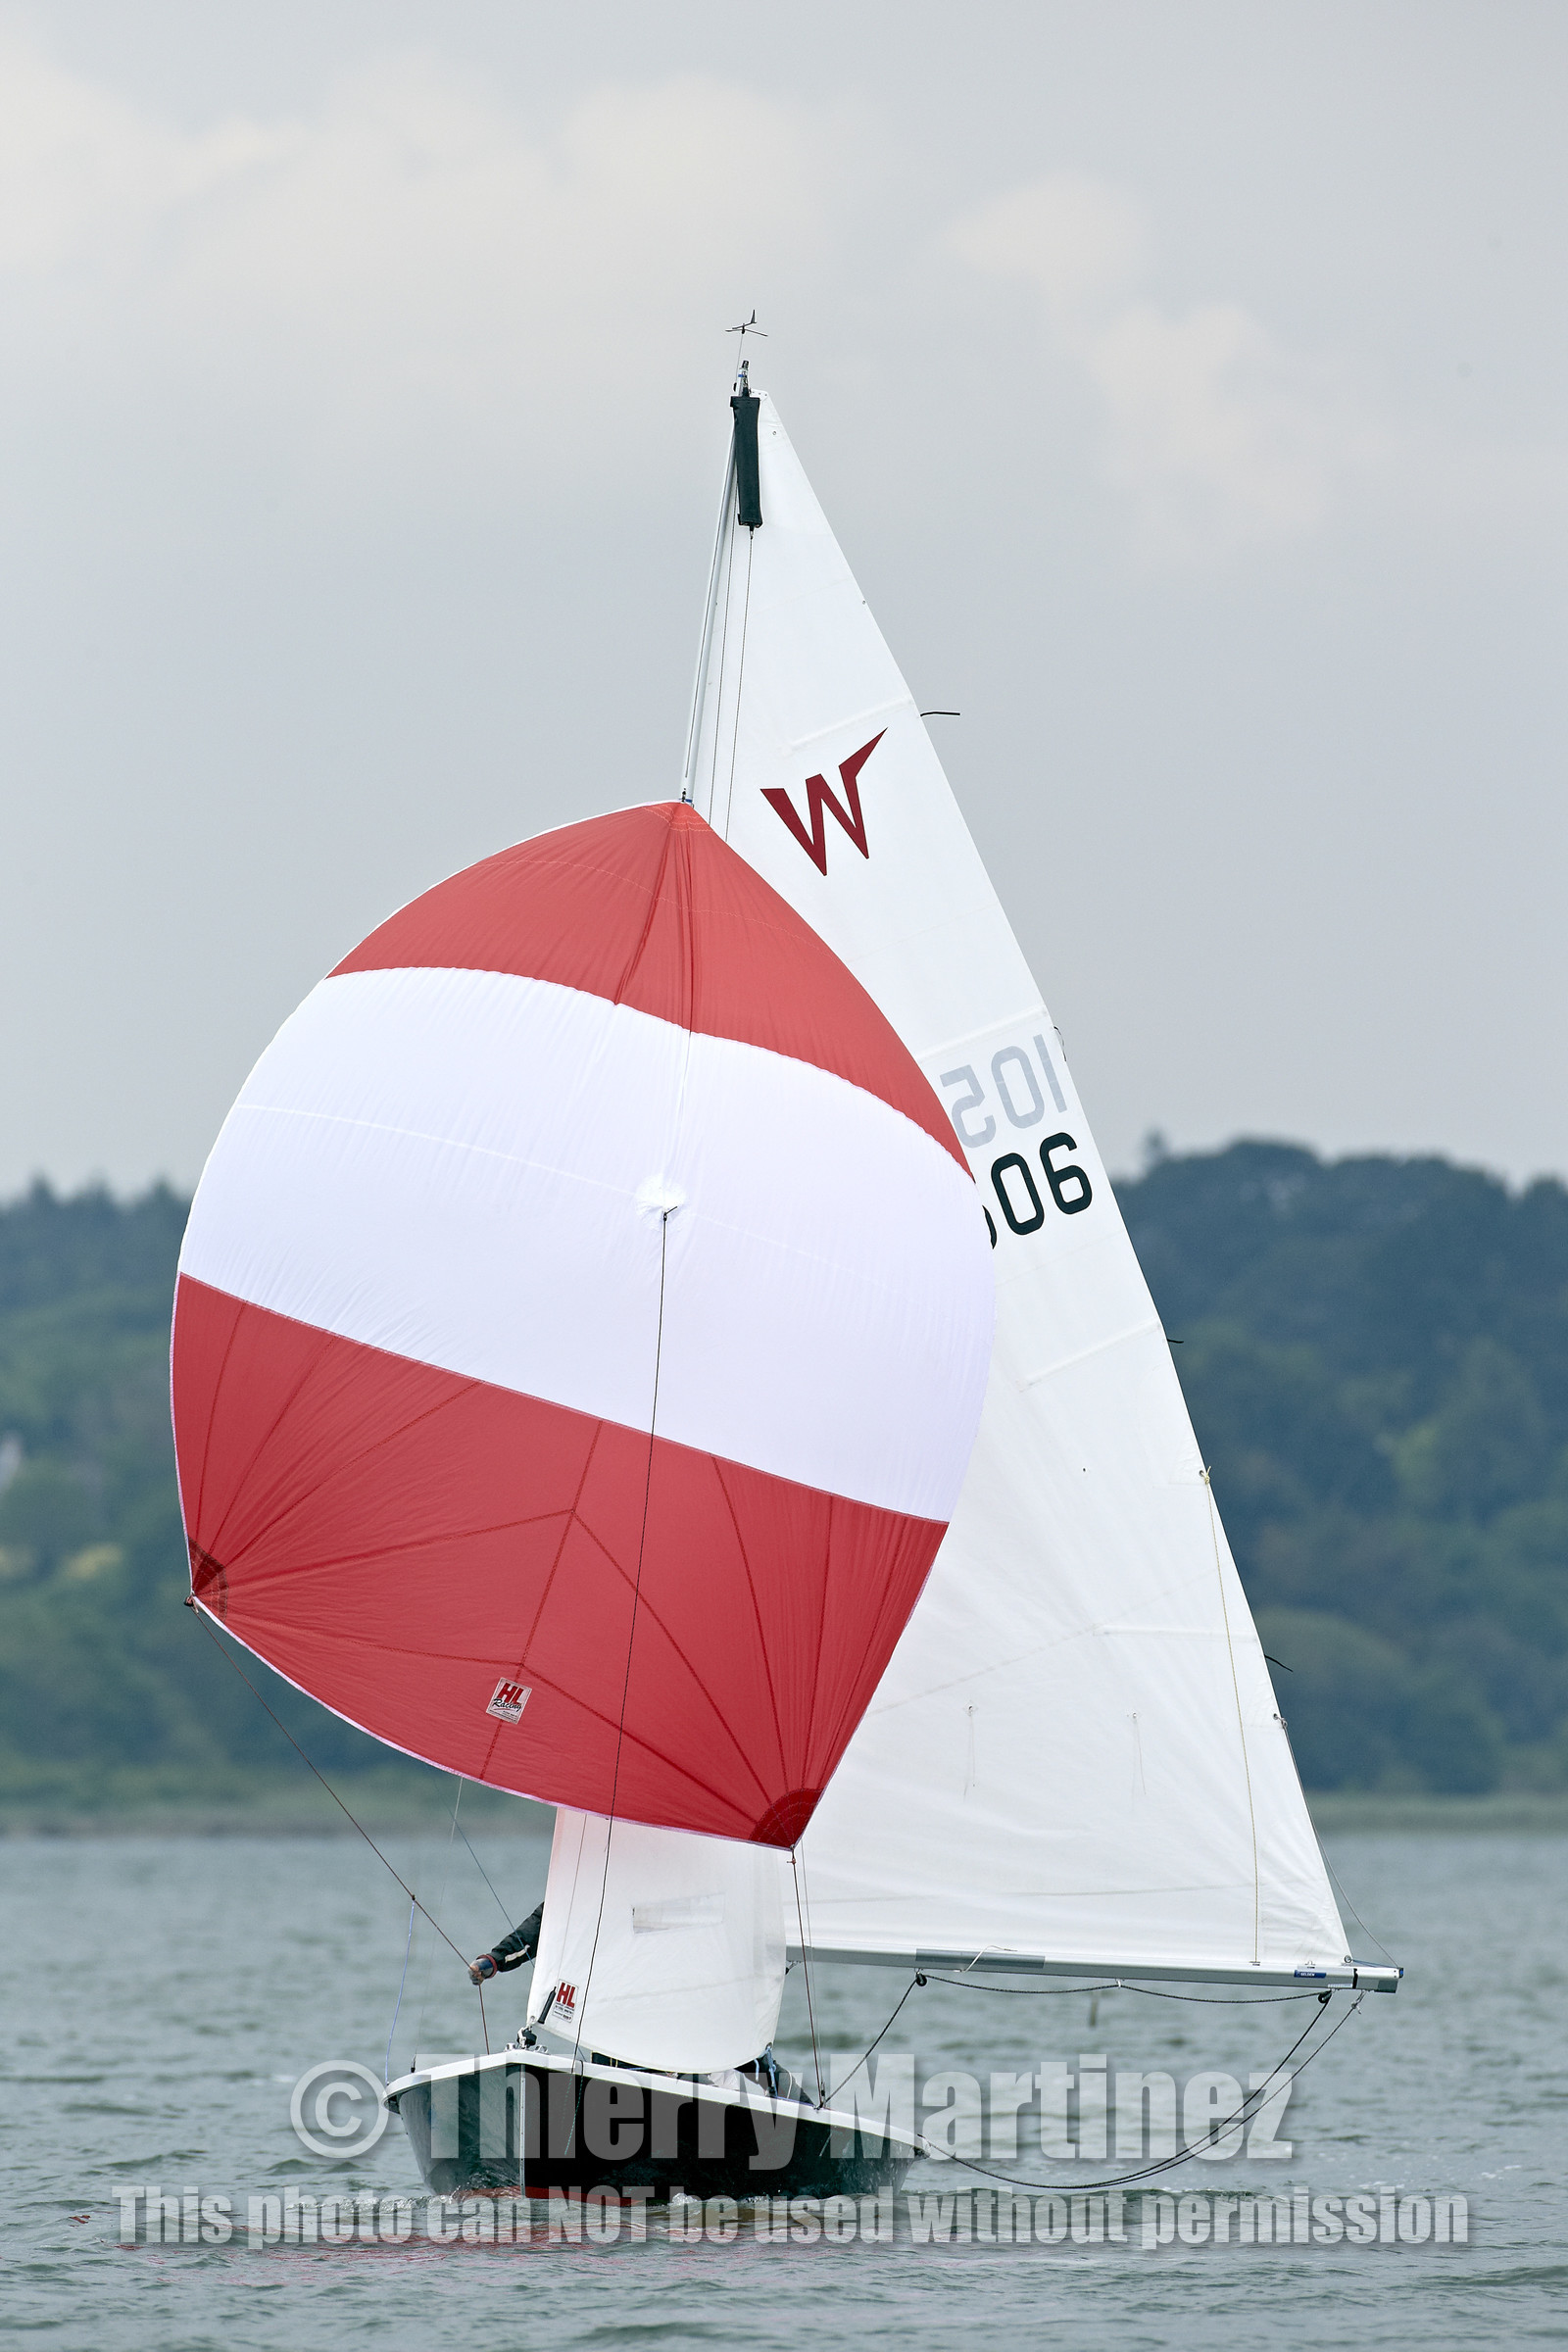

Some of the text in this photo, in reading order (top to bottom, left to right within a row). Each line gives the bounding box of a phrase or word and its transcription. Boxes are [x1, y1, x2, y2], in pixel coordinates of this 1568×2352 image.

[982, 1132, 1093, 1250] 06
[492, 1698, 522, 1712] Racing
[497, 1683, 524, 1705] HL
[557, 1982, 575, 2008] HL
